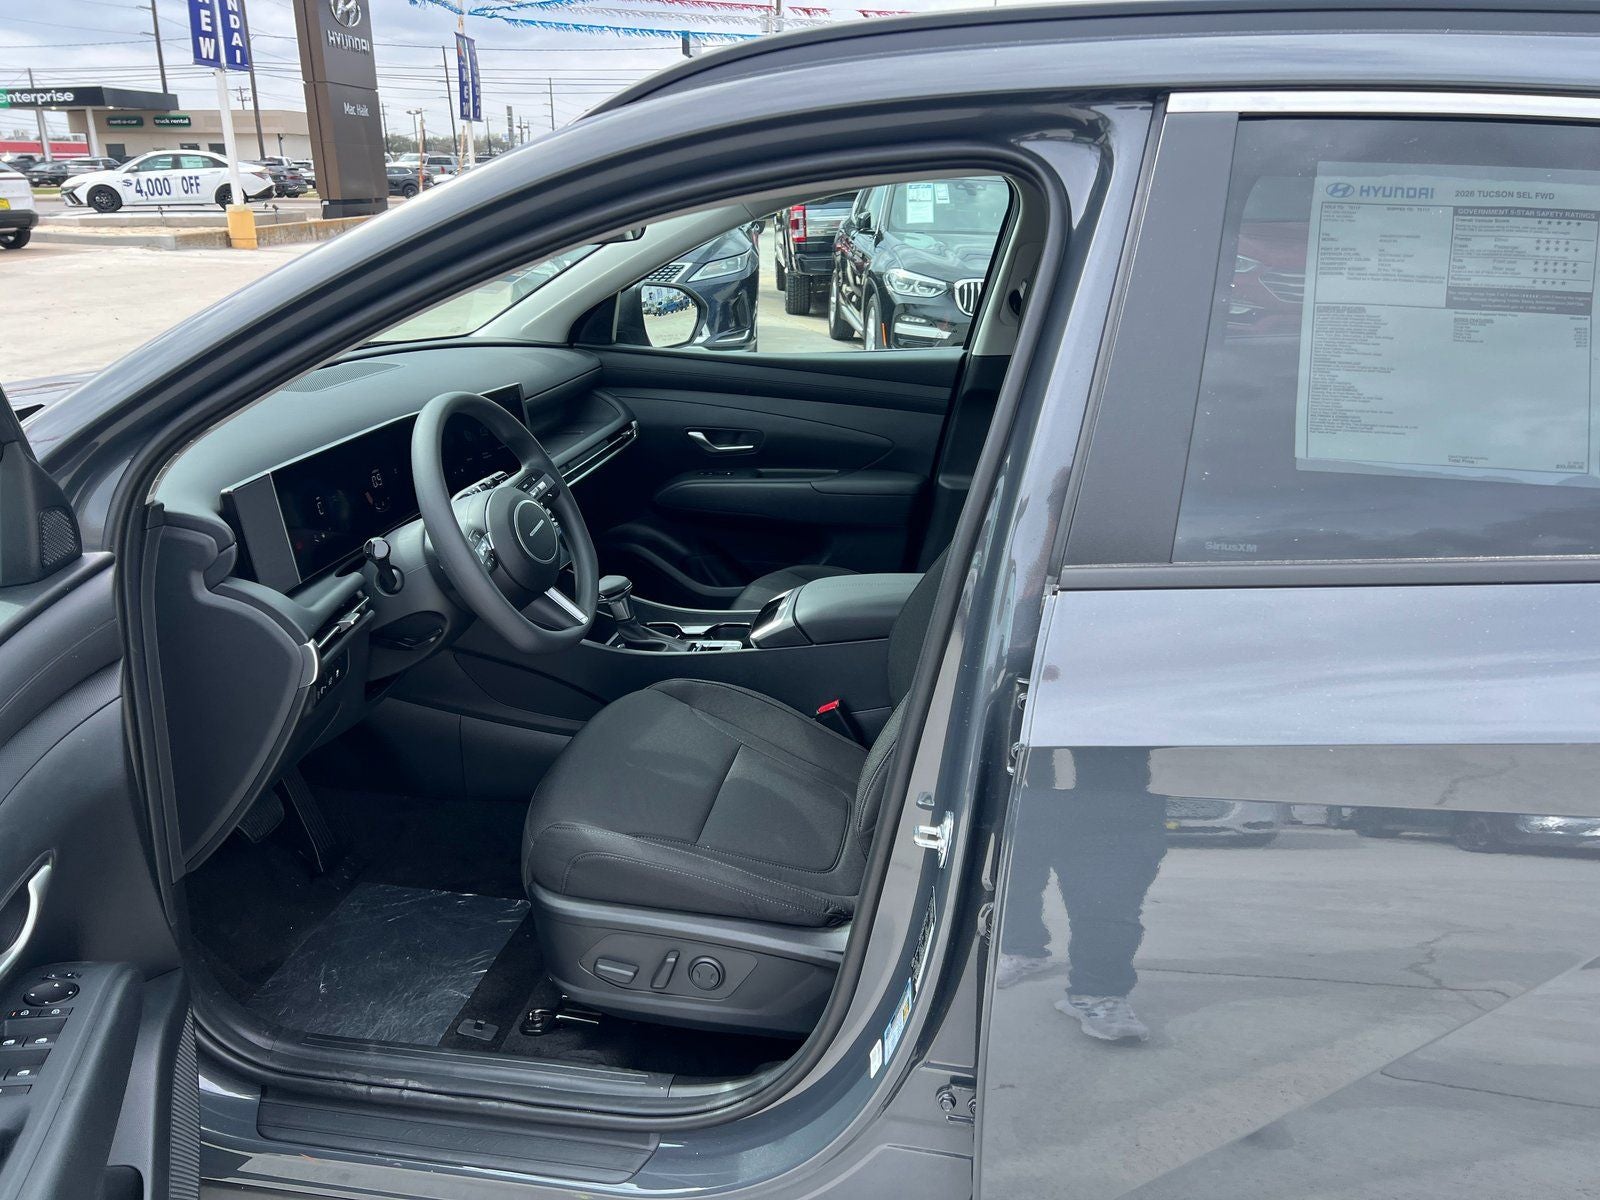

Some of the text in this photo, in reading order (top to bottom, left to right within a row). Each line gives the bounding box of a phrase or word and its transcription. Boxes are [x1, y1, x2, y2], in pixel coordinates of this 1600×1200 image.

[197, 0, 215, 60] EW
[327, 30, 370, 53] HYUNDAI
[0, 90, 74, 105] enterprise
[343, 102, 356, 115] Mac
[181, 175, 200, 194] OFF
[1360, 185, 1434, 199] HYUNDAI
[1477, 190, 1514, 198] TUCSON
[1516, 191, 1533, 199] SEL
[1535, 192, 1555, 200] FWD
[1457, 208, 1509, 216] GOVERNMENT
[1536, 210, 1563, 218] SAFETY
[1565, 211, 1596, 220] RATINGS
[1205, 541, 1257, 553] SiriusXM
